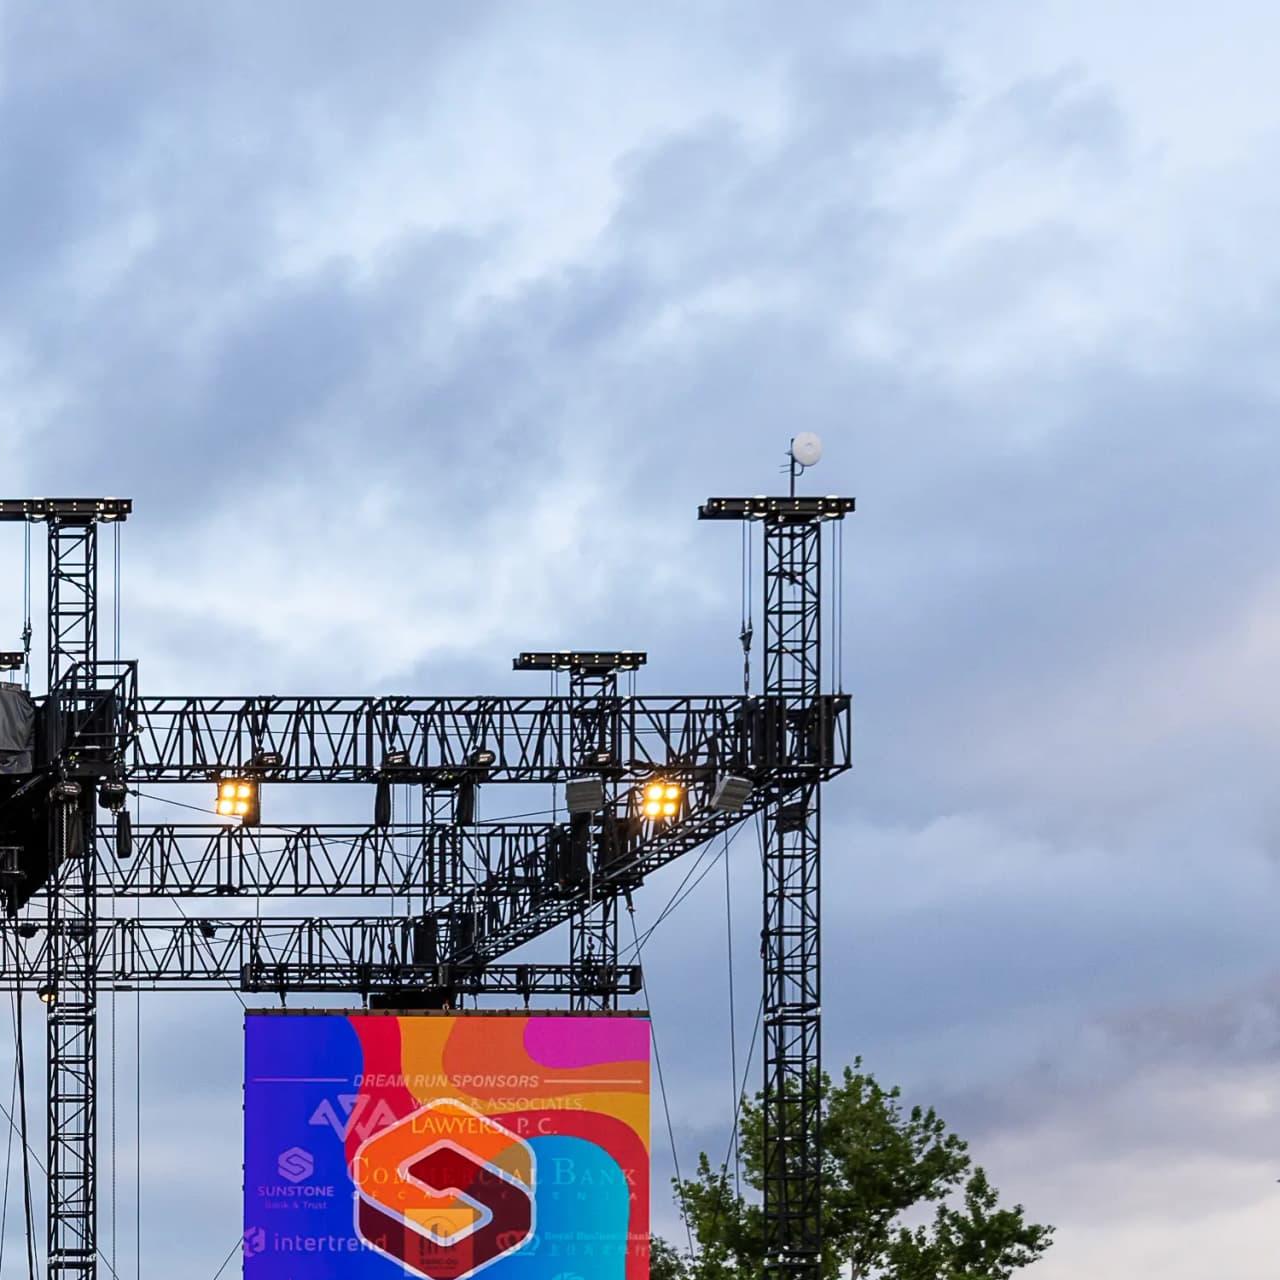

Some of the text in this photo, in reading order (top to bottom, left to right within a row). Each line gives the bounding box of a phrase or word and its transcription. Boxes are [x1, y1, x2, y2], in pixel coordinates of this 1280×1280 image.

[353, 1074, 540, 1088] DREAM RUN SPONSORS
[257, 1186, 335, 1197] SUNSTONE
[274, 1233, 387, 1251] intertrend
